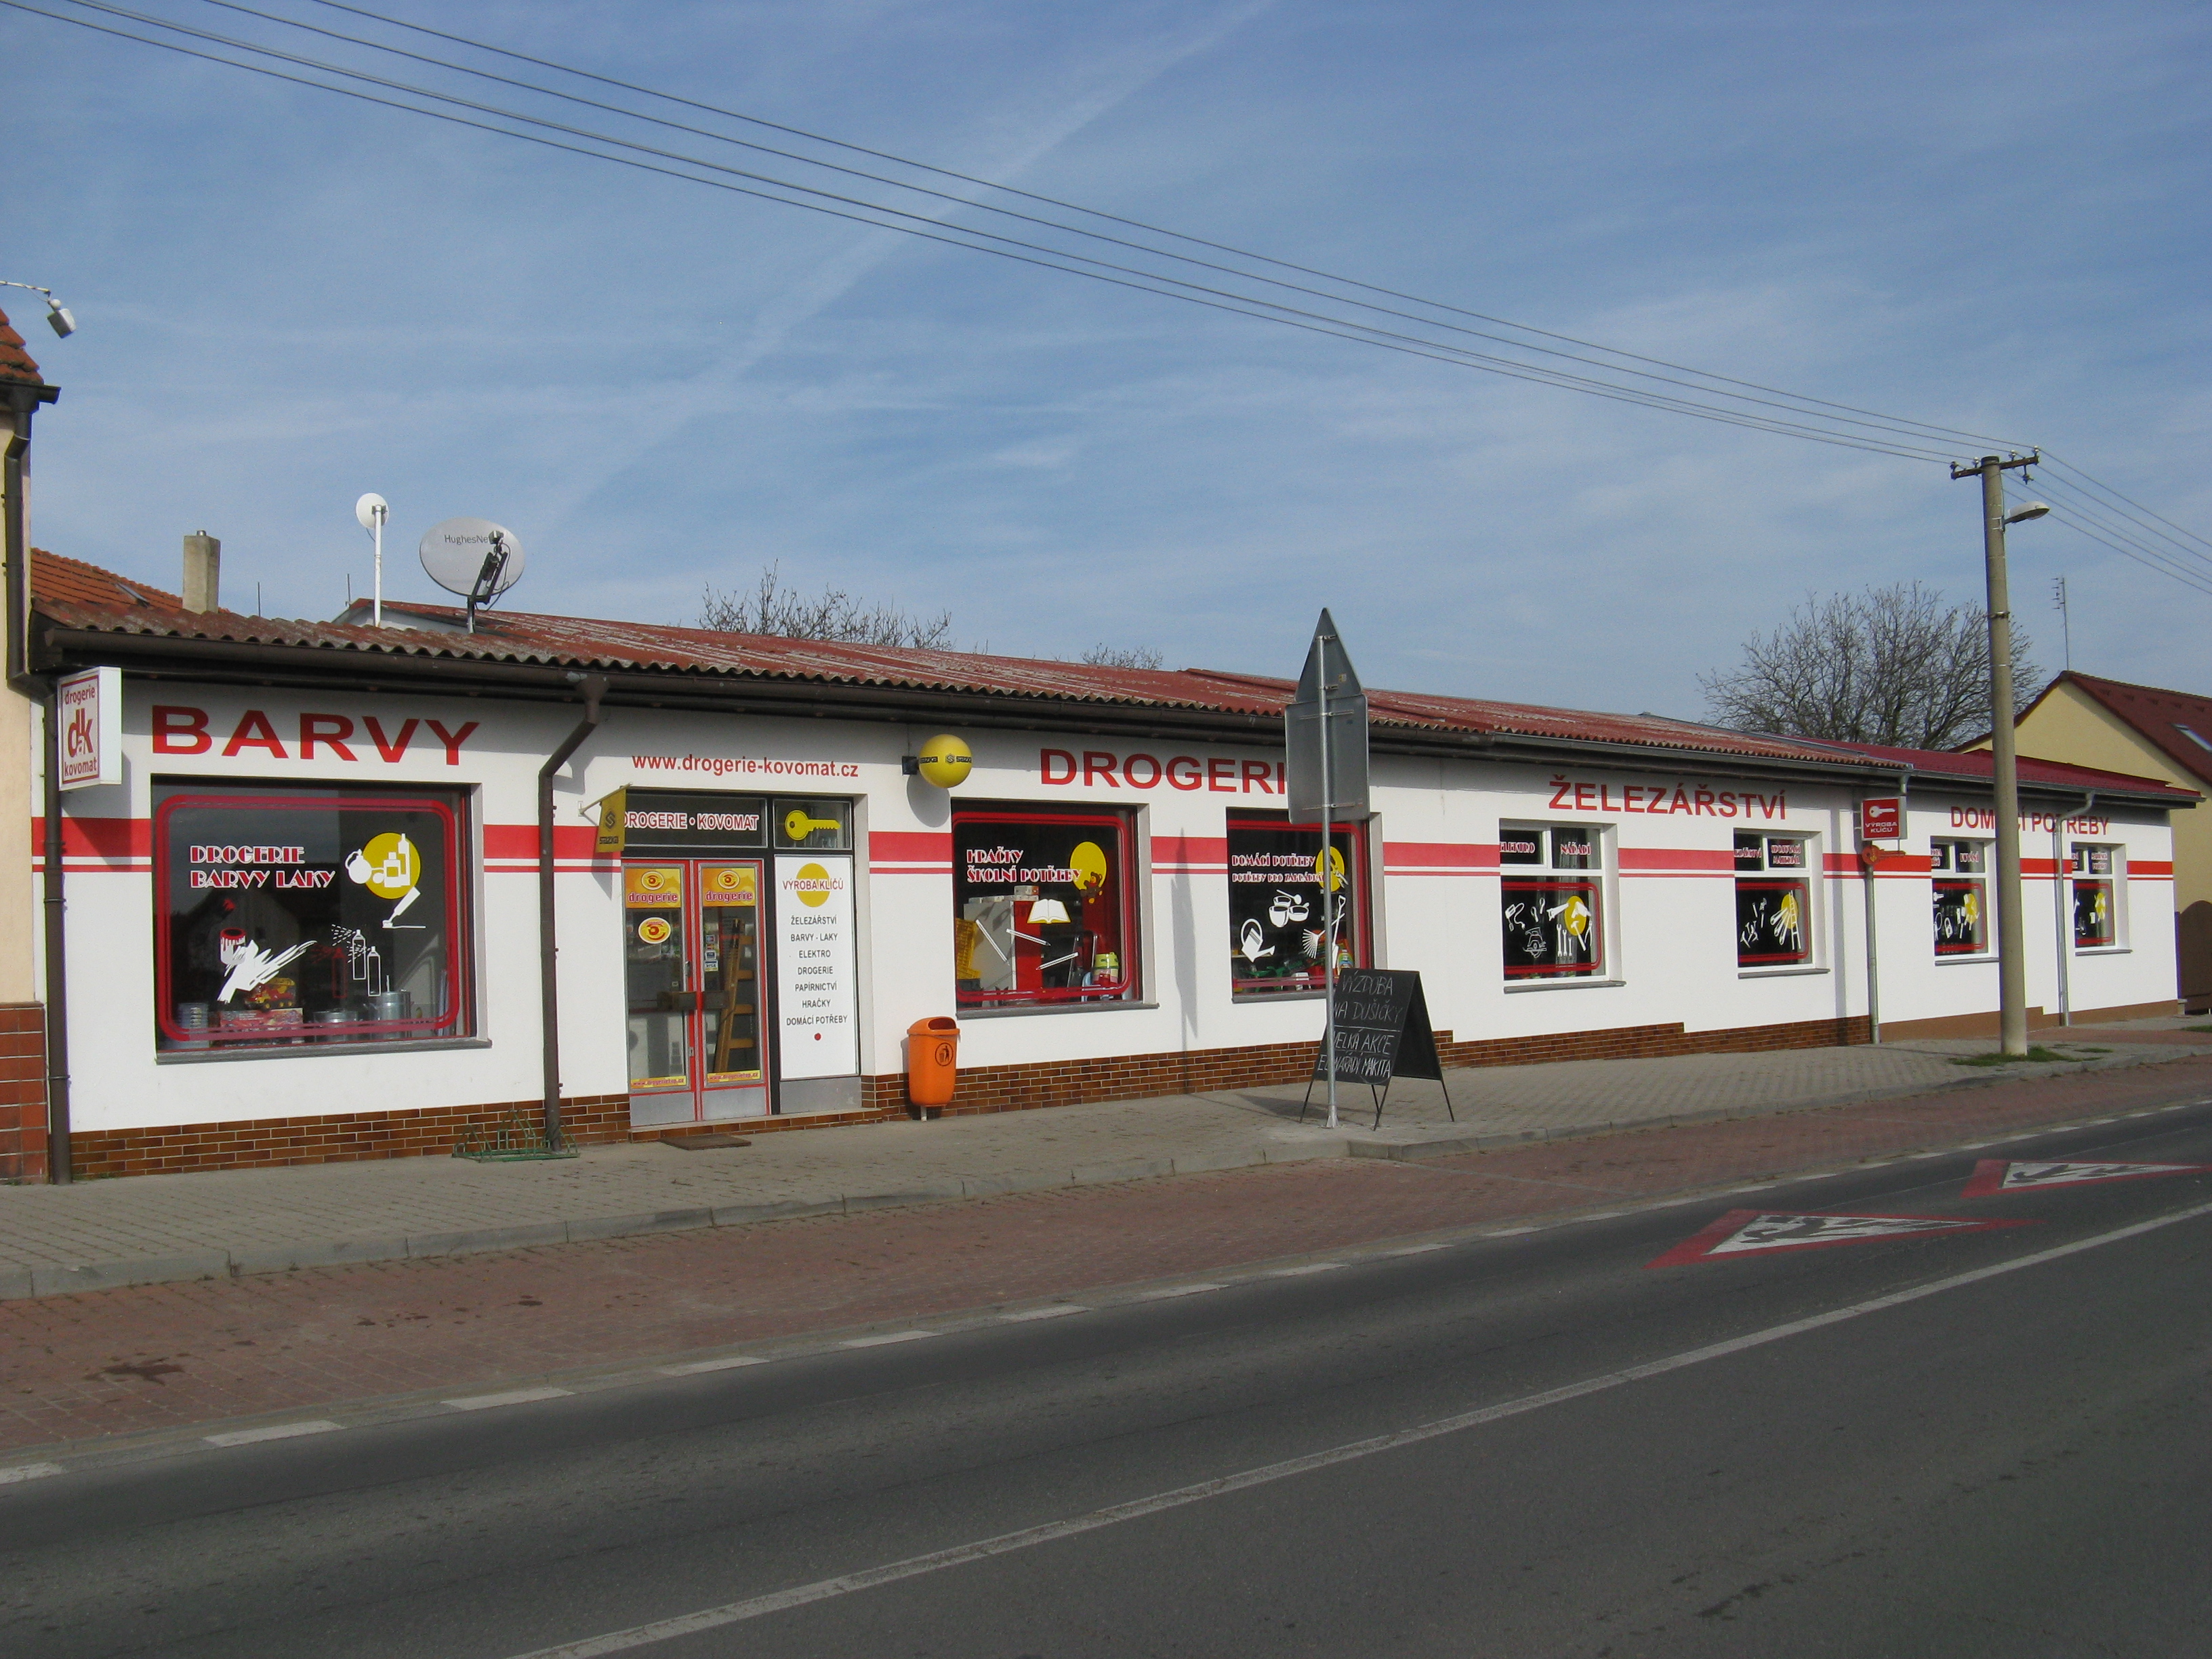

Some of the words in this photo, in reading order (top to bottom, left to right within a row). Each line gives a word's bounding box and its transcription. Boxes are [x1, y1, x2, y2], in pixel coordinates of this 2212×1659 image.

[444, 534, 490, 545] HughesNe
[64, 684, 96, 705] drogerie
[151, 704, 480, 766] BARVY
[64, 757, 97, 777] kovomat
[632, 754, 859, 777] www.drogerie-kovomat.cz
[1040, 748, 1285, 795] DROGERI
[1549, 774, 1786, 820] ŽELEZÁŘSTVÍ
[697, 813, 759, 831] KOVOMAT
[1950, 806, 2026, 832] DOMÍ
[190, 845, 306, 864] DROGERIE
[966, 846, 1023, 864] HRAČKY
[1231, 853, 1271, 867] DOMÁCÍ
[1272, 853, 1316, 867] POTŘEBY
[190, 869, 270, 889] BARVY
[275, 869, 335, 888] LAKY
[967, 865, 1017, 882] ŠKOLNÍ
[1020, 865, 1082, 882] POTŘEBY
[1232, 872, 1267, 882] POTŘEBY
[1268, 873, 1284, 882] PRO
[782, 878, 818, 890] VÝROBA
[819, 877, 844, 890] KLÍČŮ
[628, 891, 679, 904] drogerie
[705, 890, 754, 902] drogerie
[790, 914, 837, 925] ŽELEZÁŘSTVÍ
[790, 933, 814, 942] BARVY
[820, 933, 838, 941] LAKY
[798, 949, 831, 958] ELEKTRO
[798, 966, 834, 975] DROGERIE
[795, 981, 837, 991] PAPÍRNICTVÍ
[802, 998, 831, 1008] HRAČKY
[1352, 998, 1403, 1024] DUŠIČKY
[786, 1015, 814, 1025] DOMÁCÍ
[815, 1014, 848, 1024] POTŘEBY
[1361, 1033, 1395, 1055] AKCE
[1361, 1058, 1391, 1078] MAKITA
